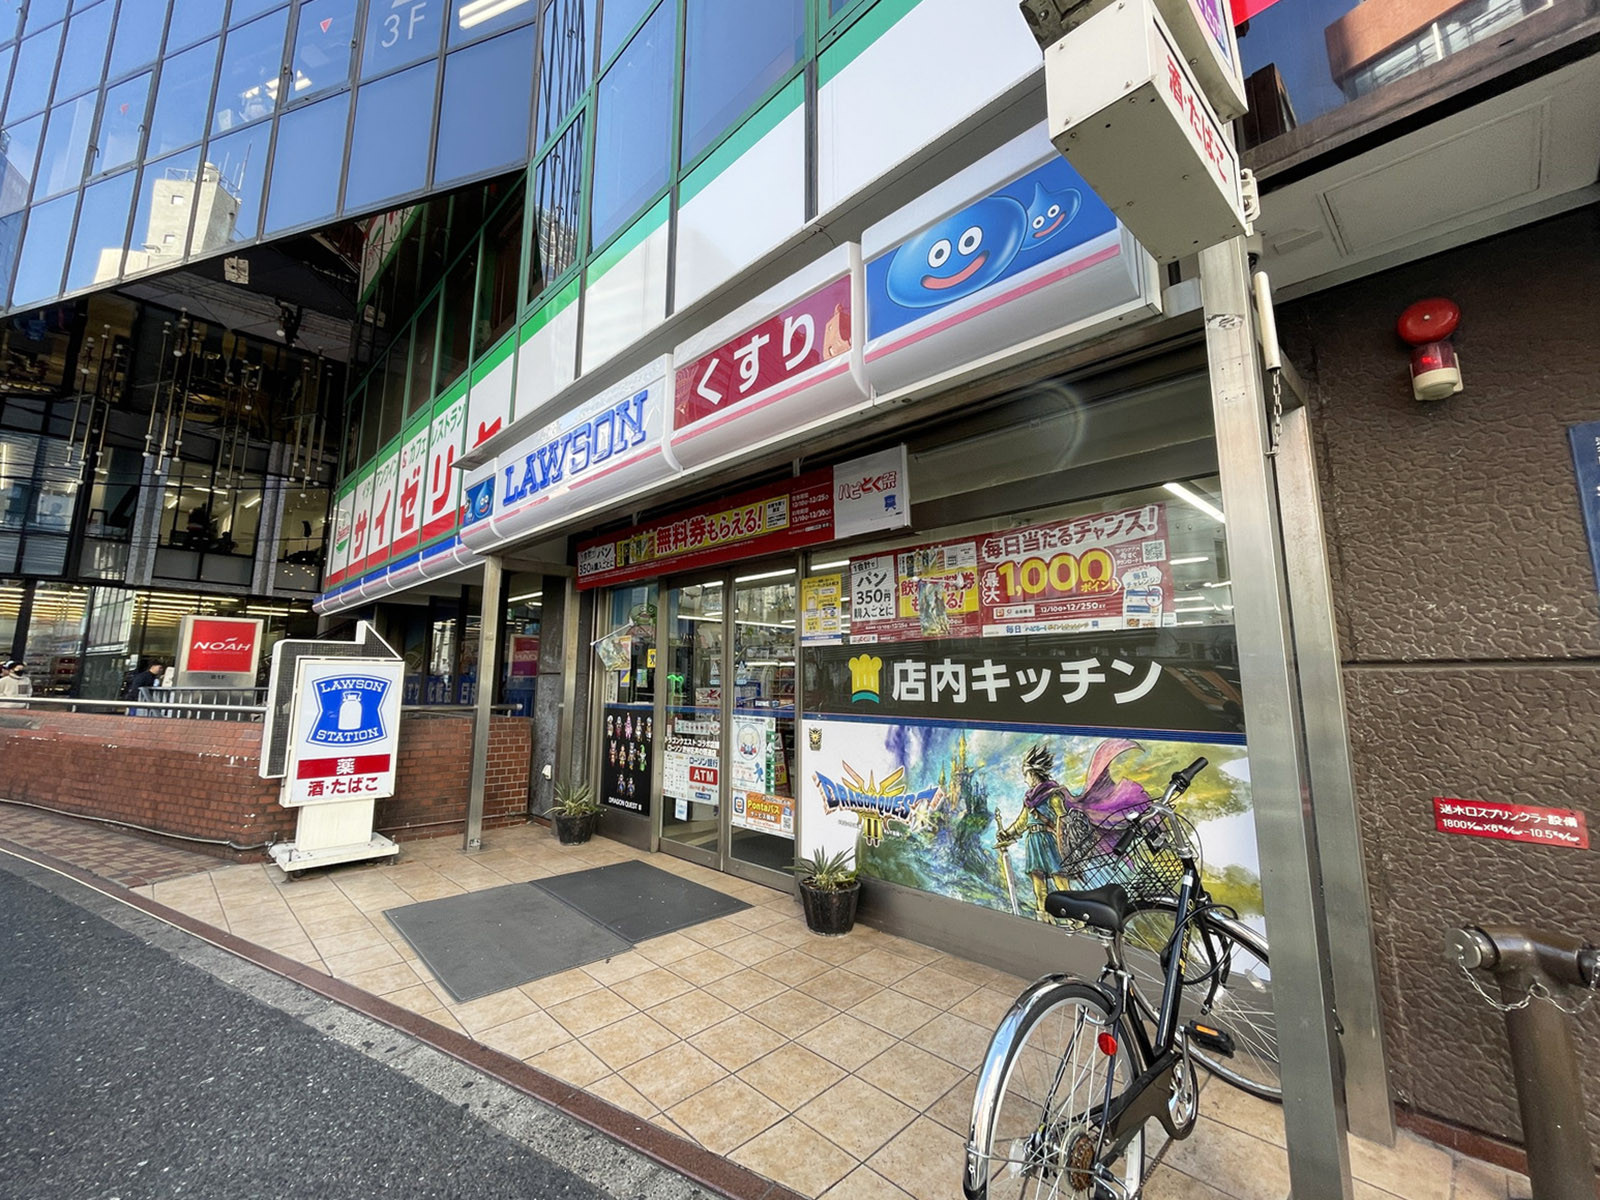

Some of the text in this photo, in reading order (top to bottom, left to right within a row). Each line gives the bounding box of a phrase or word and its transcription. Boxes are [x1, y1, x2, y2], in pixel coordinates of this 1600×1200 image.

[381, 2, 427, 48] 3F
[696, 312, 815, 406] くすり
[502, 388, 649, 507] LAWSON
[838, 471, 897, 500] ハピとく祭
[985, 505, 1157, 559] 毎日当たるチャンス!
[856, 571, 888, 588] パン
[998, 548, 1113, 598] 1,000
[1080, 580, 1119, 594] ポイント
[856, 588, 891, 606] 350円
[320, 678, 384, 693] LAWSON
[891, 657, 1163, 705] 店内キッチン
[316, 727, 379, 742] STATION
[336, 758, 355, 776] 薬
[693, 769, 714, 783] ATM
[307, 776, 379, 797] 酒・たばこ
[608, 796, 625, 807] DRAGON
[1439, 803, 1578, 828] 送水口スプリンクラー設備
